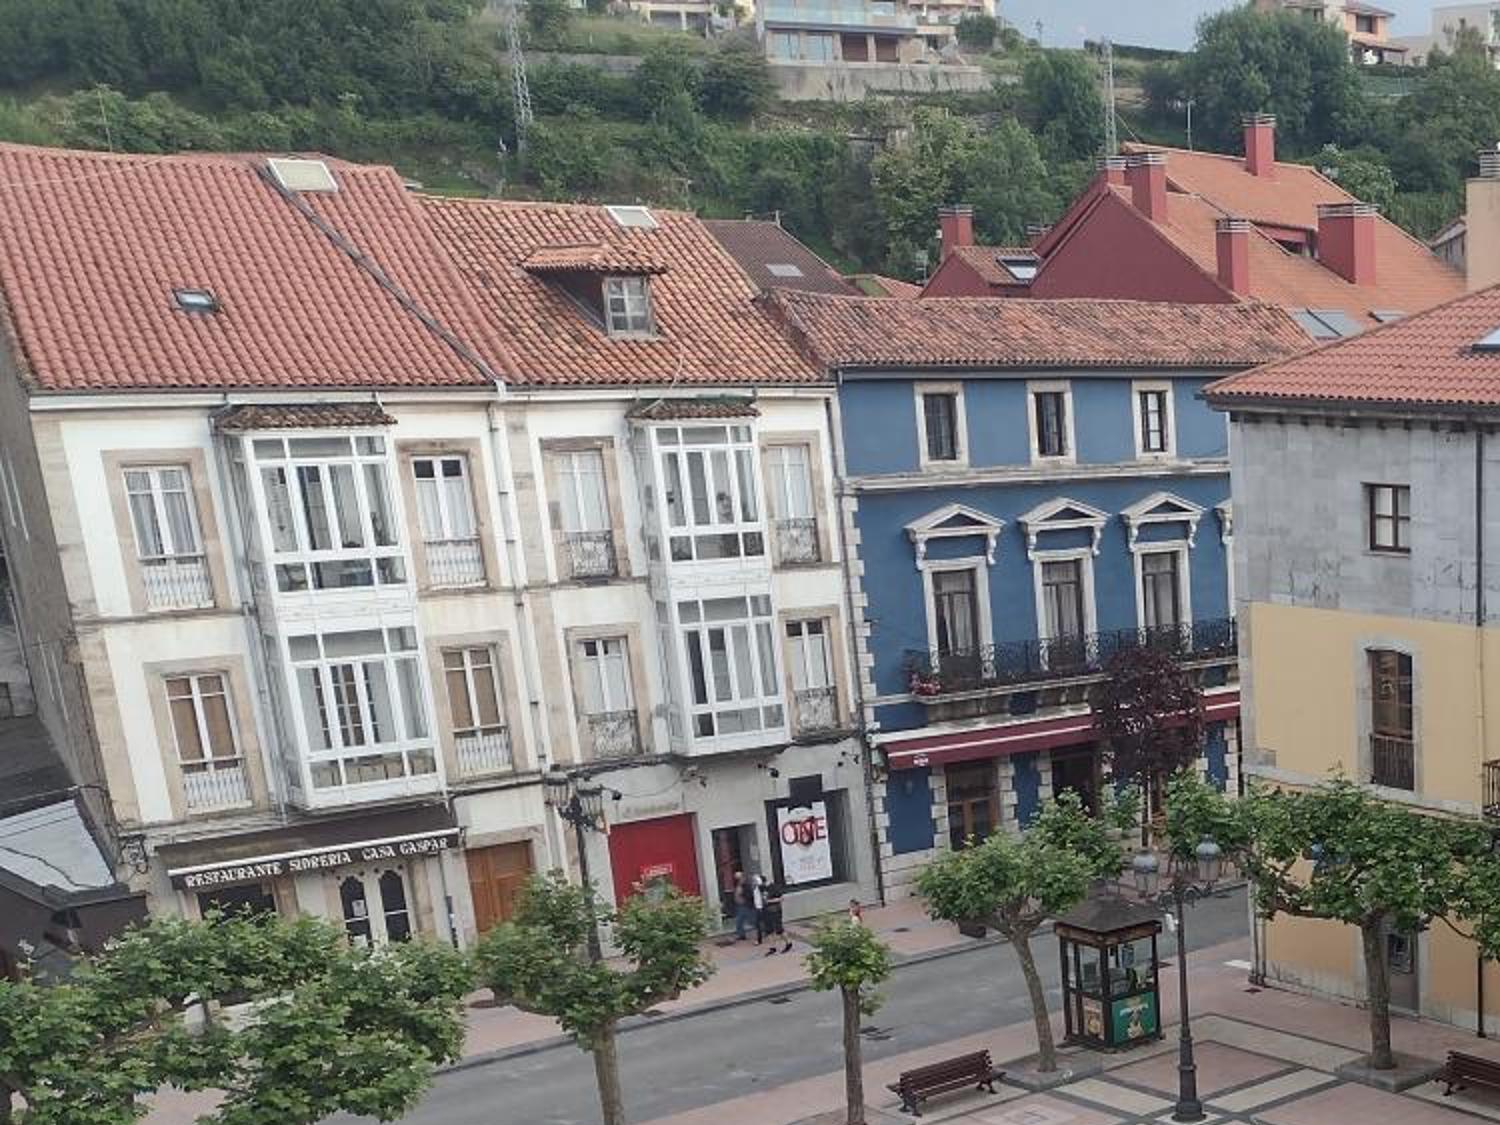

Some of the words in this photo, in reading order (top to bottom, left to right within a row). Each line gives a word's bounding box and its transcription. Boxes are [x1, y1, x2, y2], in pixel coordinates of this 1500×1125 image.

[185, 862, 282, 887] RESTAURANTE
[361, 846, 396, 860] CASA
[400, 838, 449, 854] GASPAR
